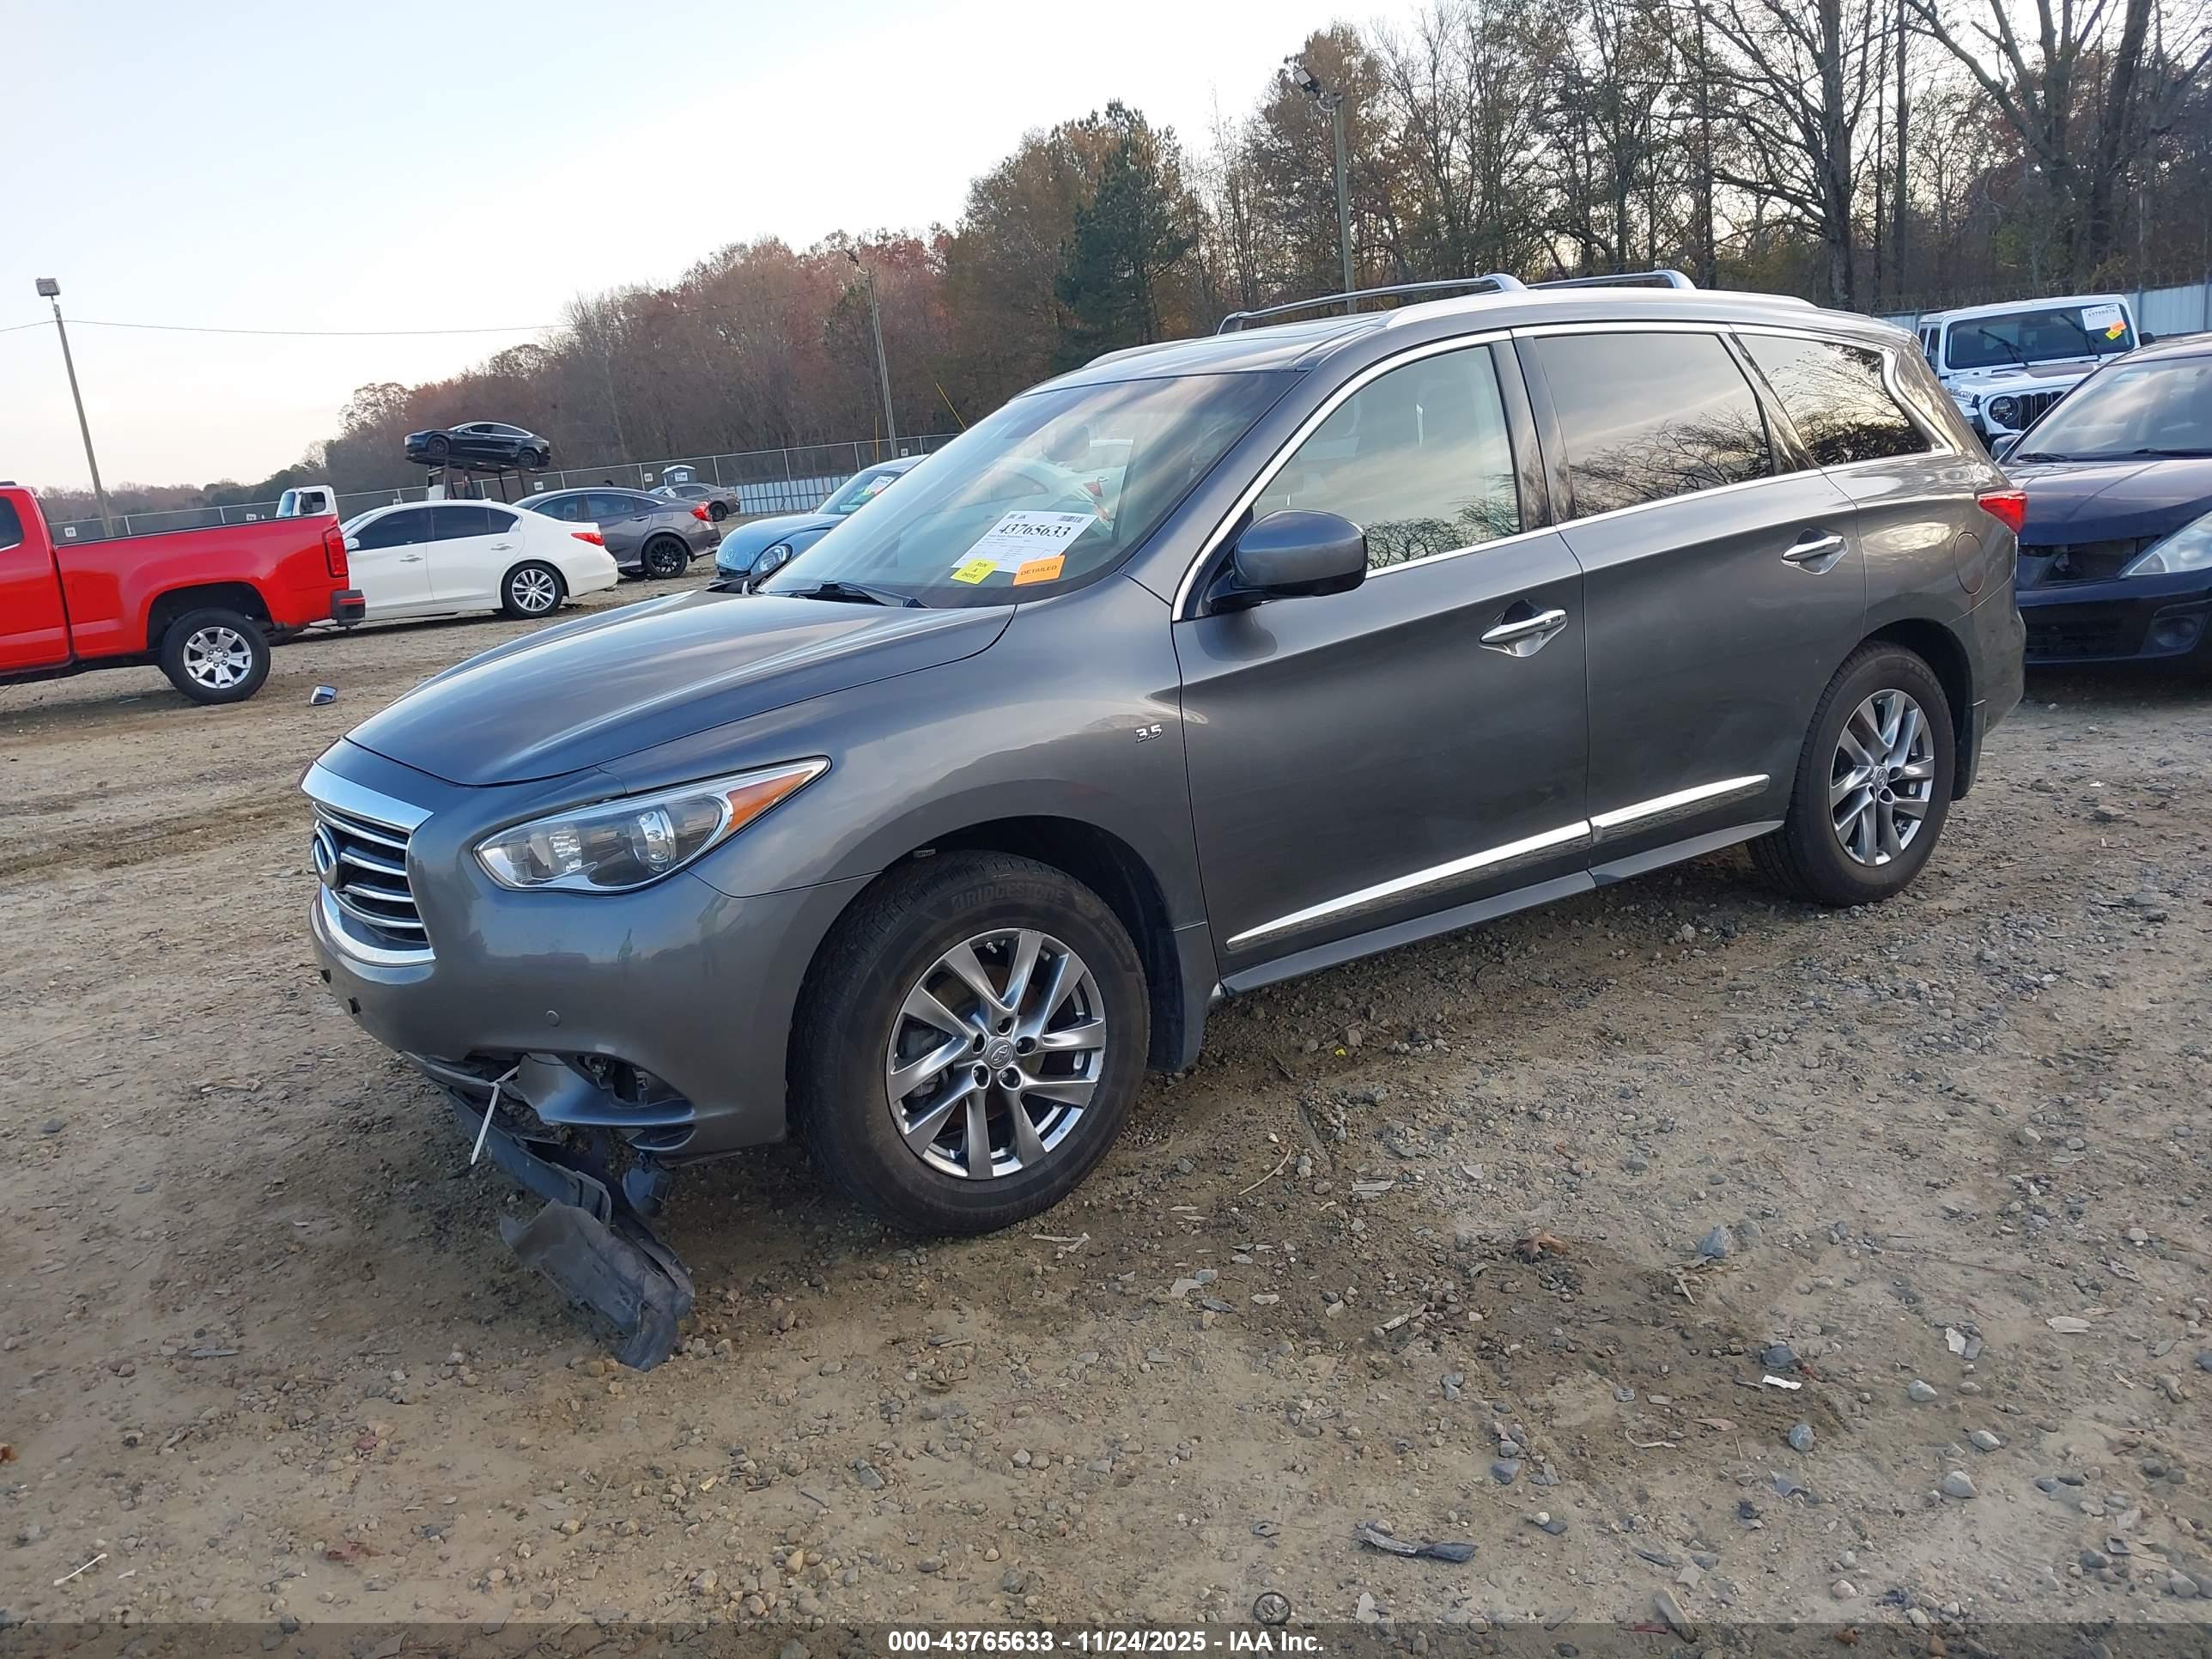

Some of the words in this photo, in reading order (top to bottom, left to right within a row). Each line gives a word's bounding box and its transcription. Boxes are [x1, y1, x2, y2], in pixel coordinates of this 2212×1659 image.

[999, 523, 1072, 538] 43765633
[1020, 565, 1058, 576] DETAILED
[1135, 724, 1163, 743] 3.5
